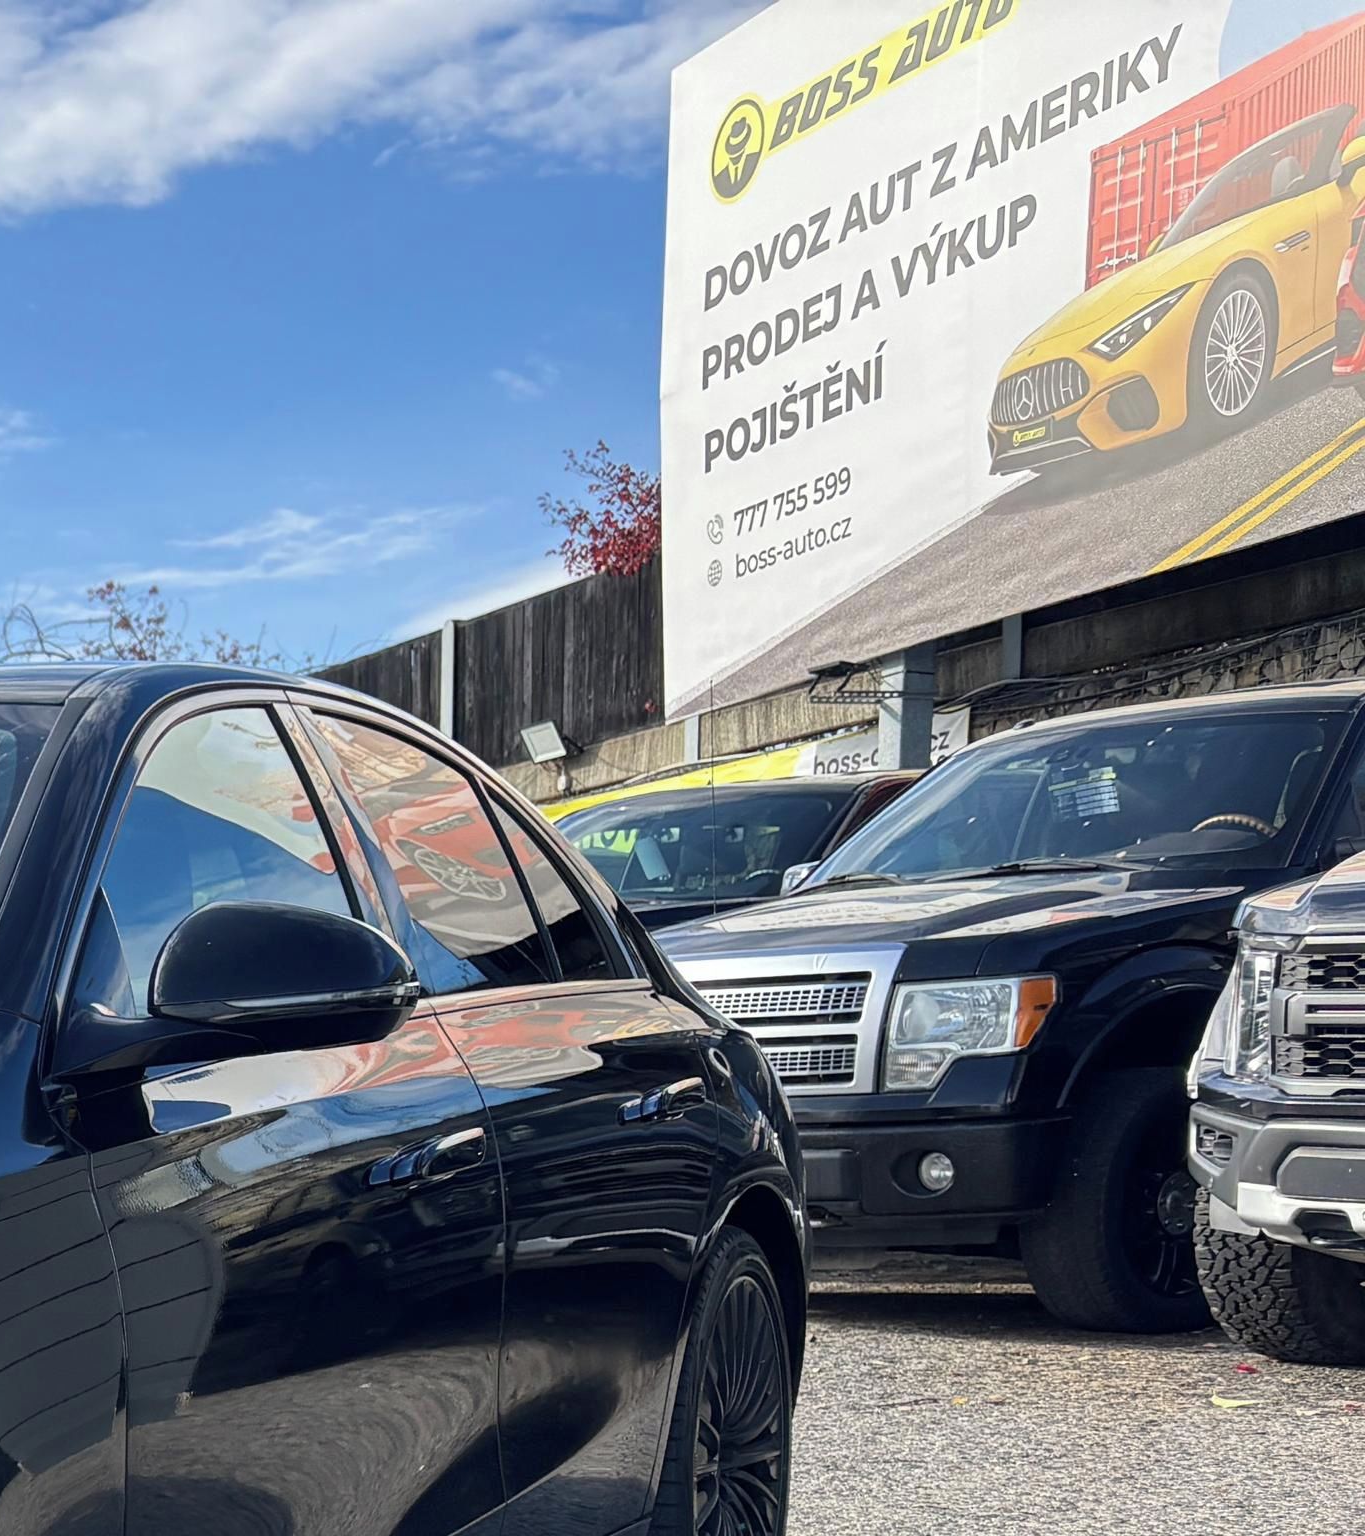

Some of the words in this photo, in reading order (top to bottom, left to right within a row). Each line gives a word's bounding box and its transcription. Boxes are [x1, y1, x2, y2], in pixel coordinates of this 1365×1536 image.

[769, 45, 882, 151] BOSS
[889, 0, 1013, 84] AUTO
[703, 207, 832, 312] DOVOZ
[838, 160, 922, 244] AUT
[929, 142, 958, 199] Z
[965, 23, 1183, 182] AMERIKY
[702, 283, 842, 391] PRODEJ
[850, 268, 881, 321] A
[890, 193, 1037, 299] VÝKUP
[703, 339, 888, 475] POJIŠTĚNÍ
[733, 498, 768, 536] 777
[773, 483, 808, 521] 755
[813, 466, 851, 505] 599
[735, 516, 852, 579] boss-auto.cz
